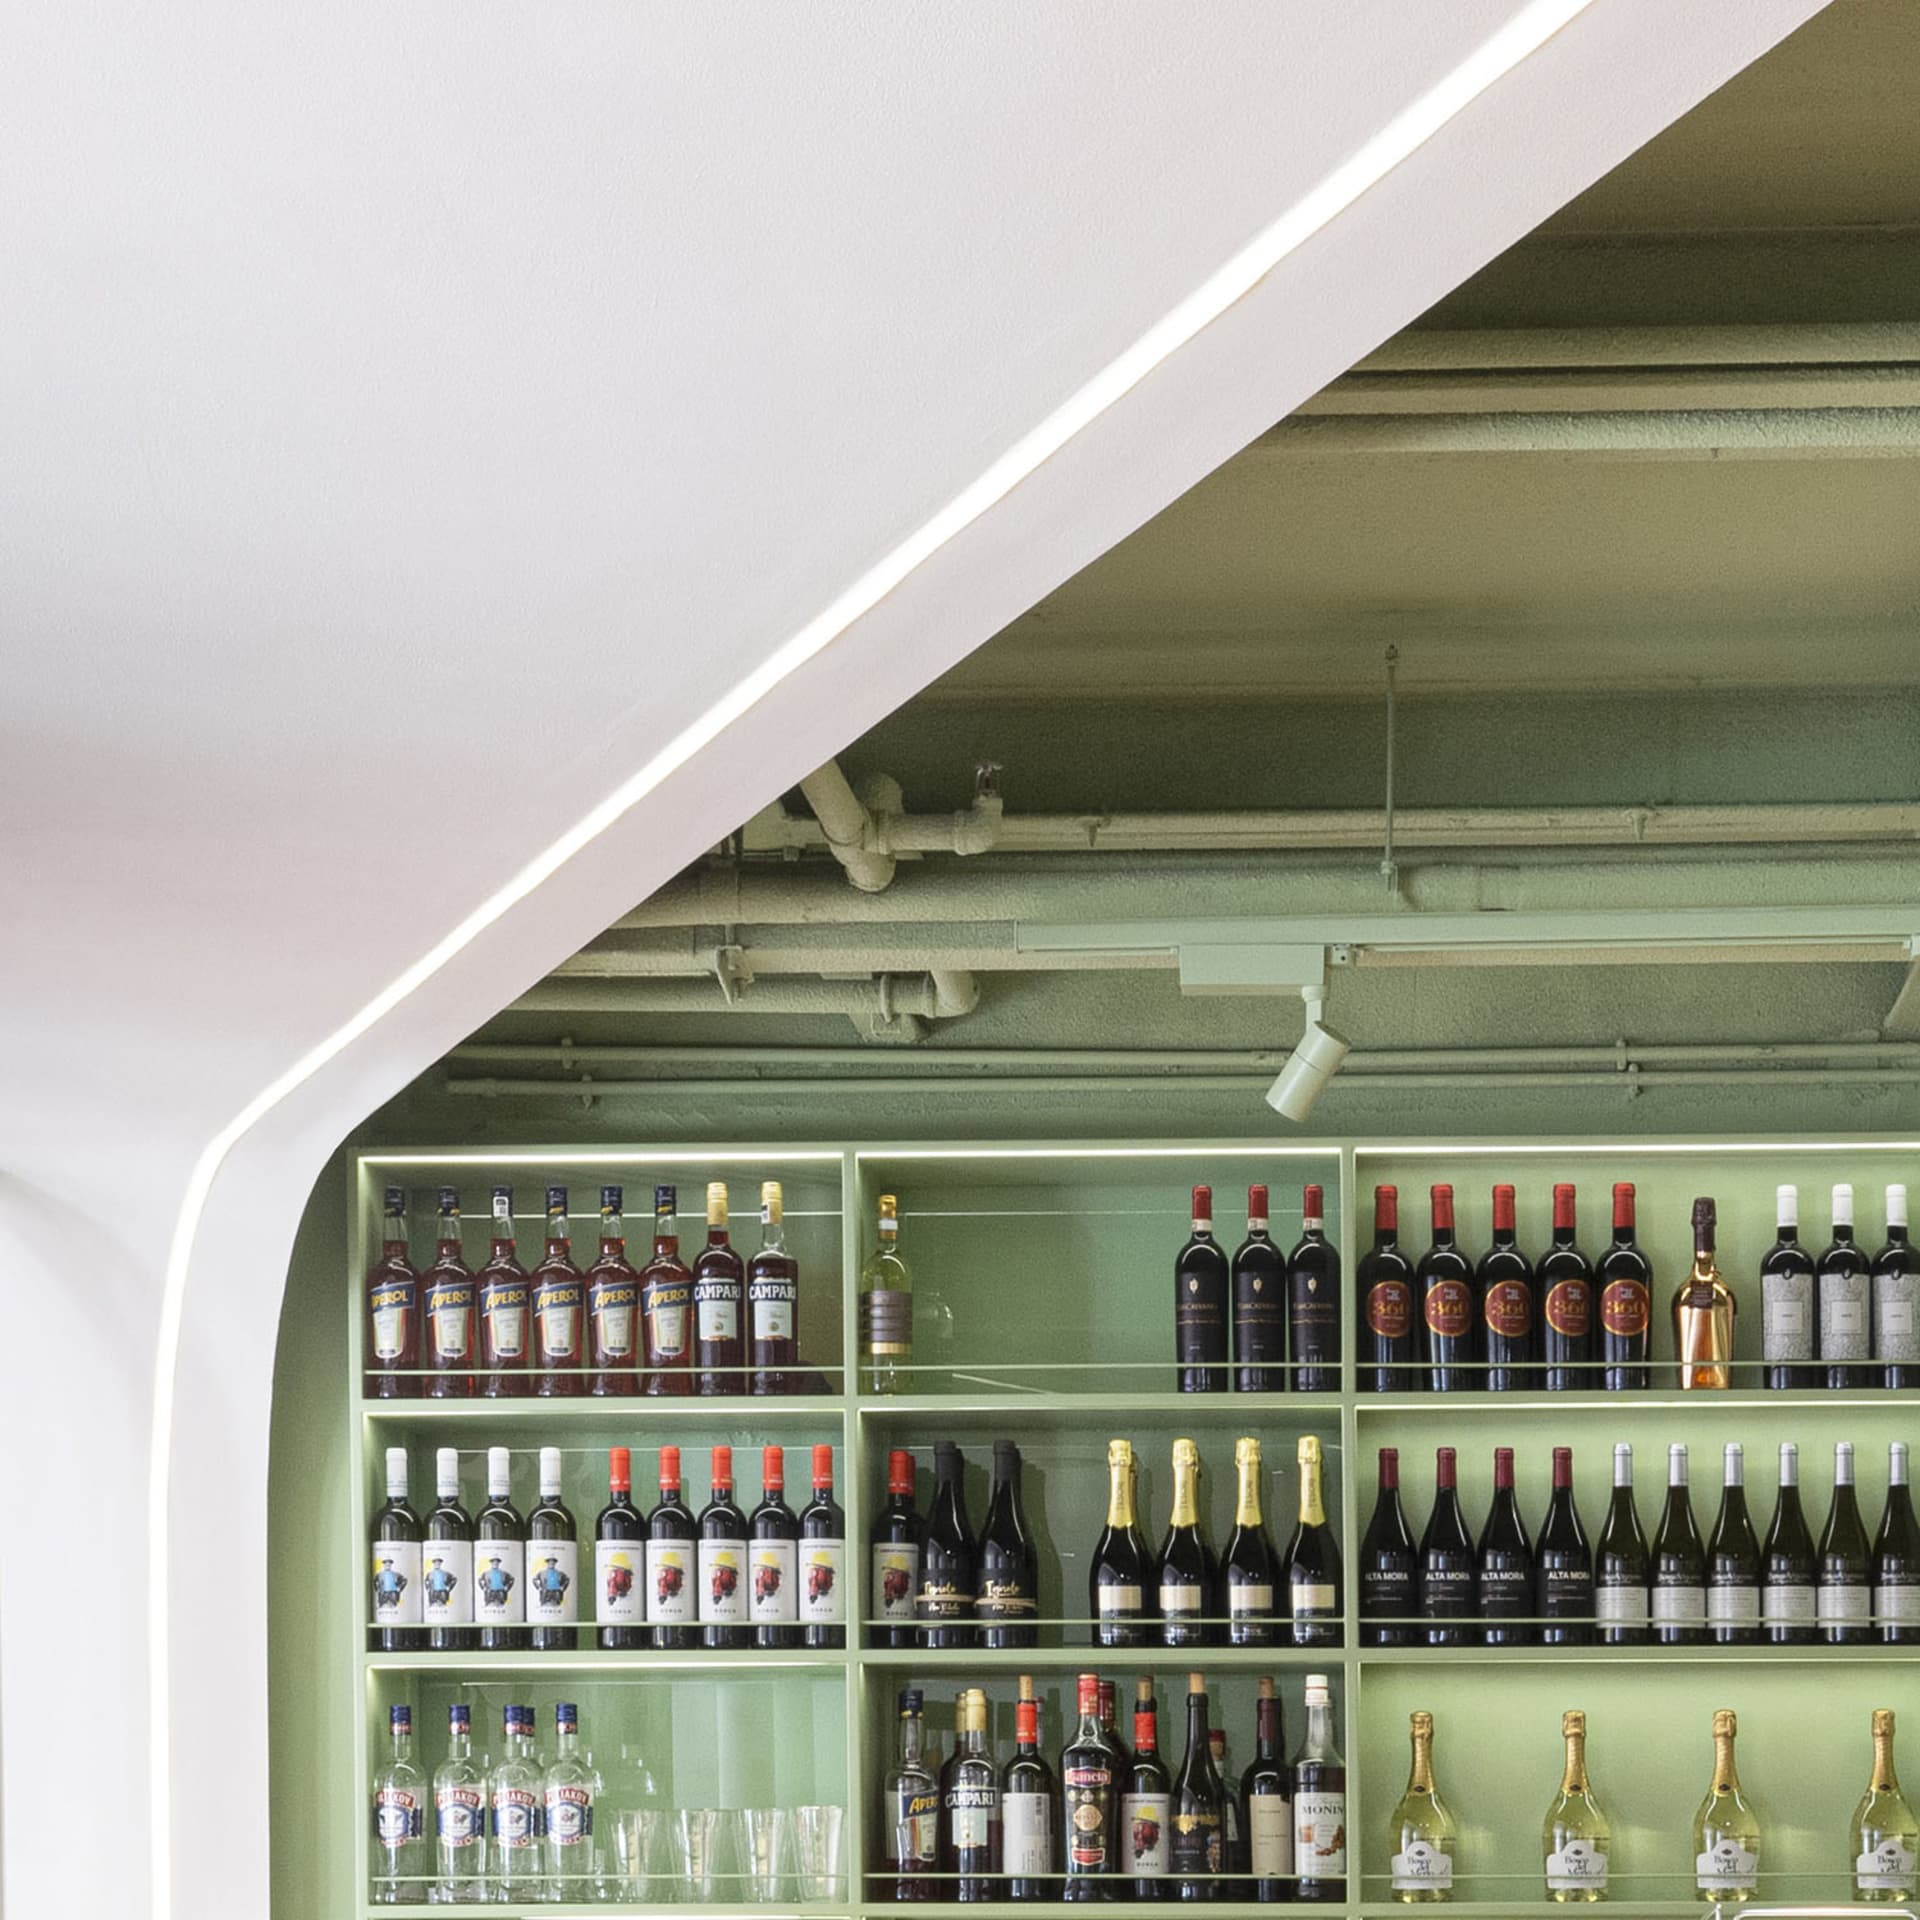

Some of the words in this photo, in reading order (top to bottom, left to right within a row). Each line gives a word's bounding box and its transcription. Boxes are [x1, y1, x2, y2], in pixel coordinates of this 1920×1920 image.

[694, 1285, 741, 1300] CAMPARI
[749, 1285, 796, 1300] CAMPARI
[1365, 1572, 1382, 1581] ALTA
[1425, 1572, 1445, 1581] ALTA
[1481, 1571, 1498, 1581] ALTA
[1547, 1571, 1569, 1580] ALTA
[945, 1792, 994, 1808] CAMPARI
